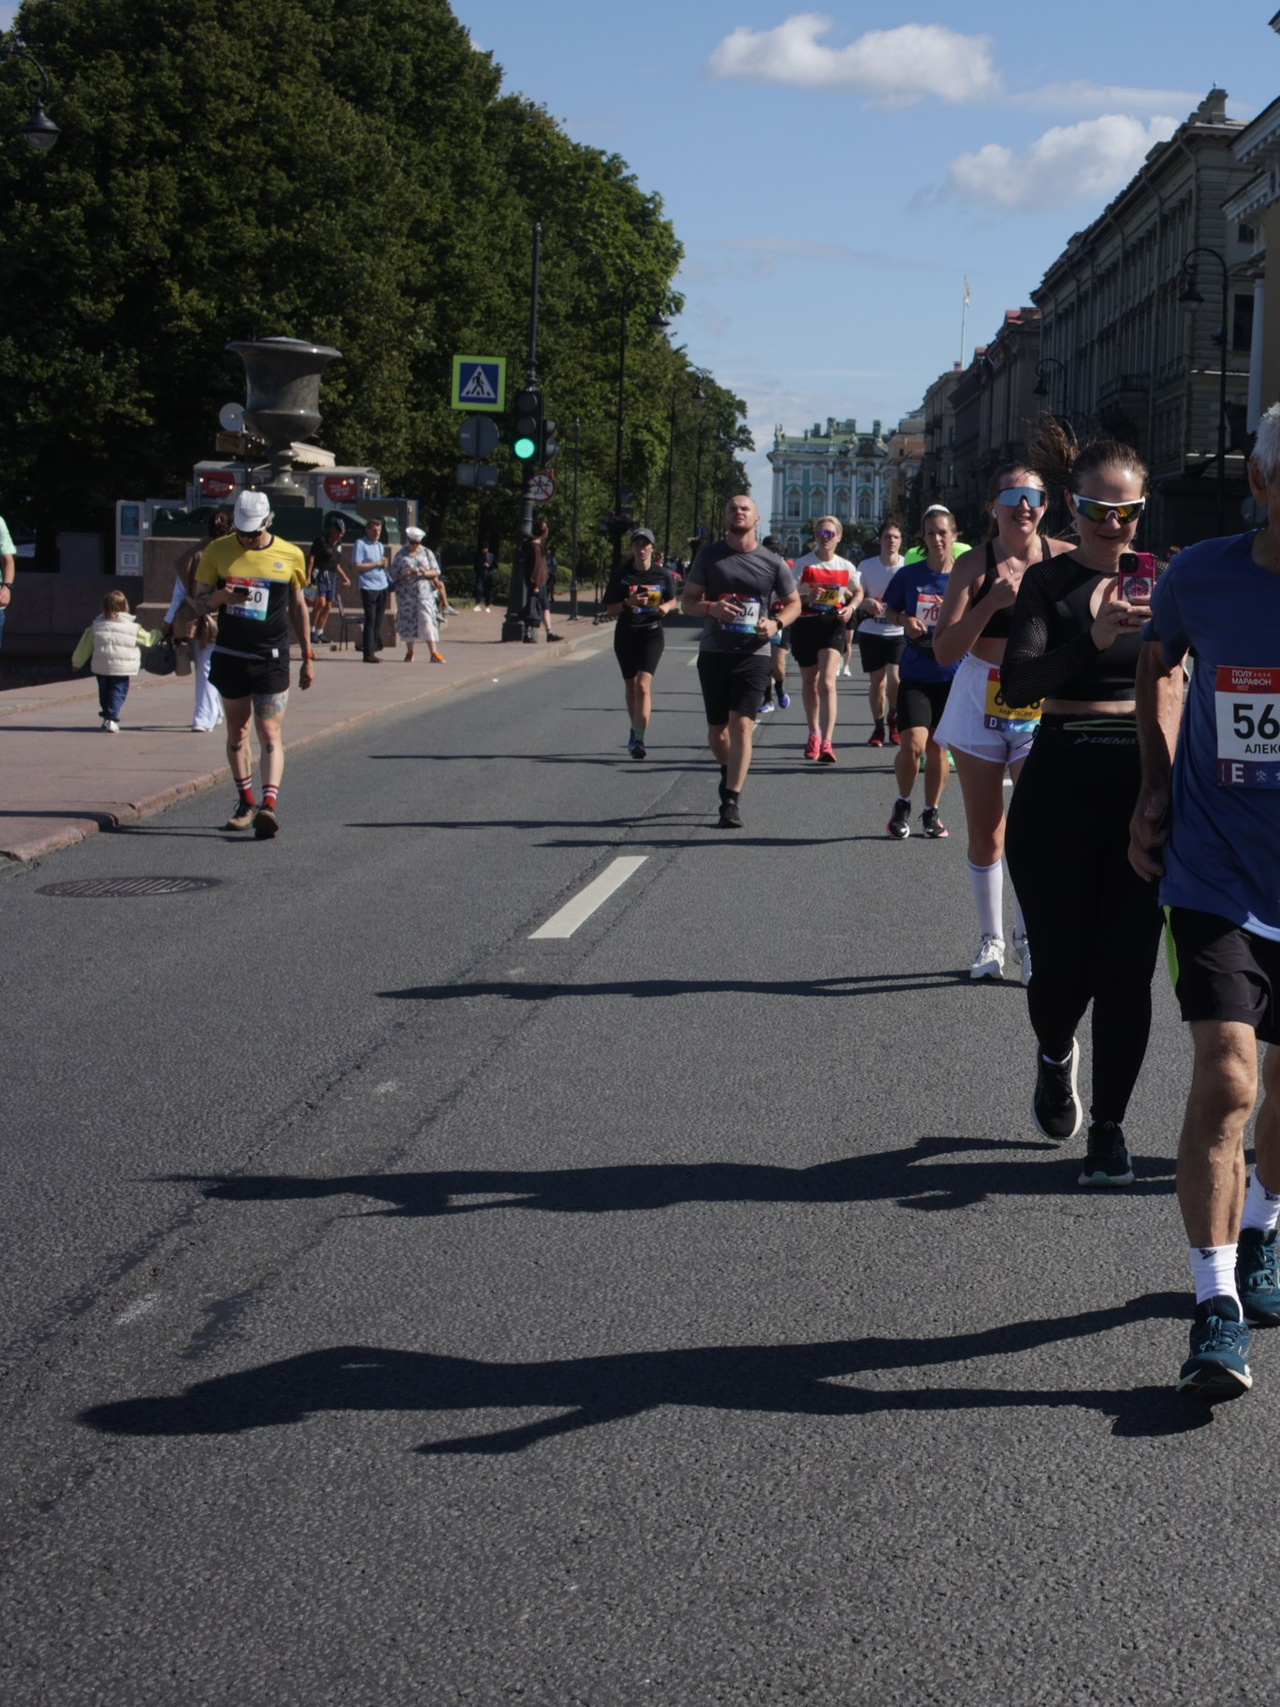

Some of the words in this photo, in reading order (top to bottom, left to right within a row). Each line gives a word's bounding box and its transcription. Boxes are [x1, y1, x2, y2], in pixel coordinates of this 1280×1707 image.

[1231, 669, 1253, 678] ПОЛУ
[1231, 677, 1272, 686] МАРАФОН
[989, 717, 998, 728] D
[1089, 736, 1139, 746] DEMIX
[1231, 762, 1245, 784] E
